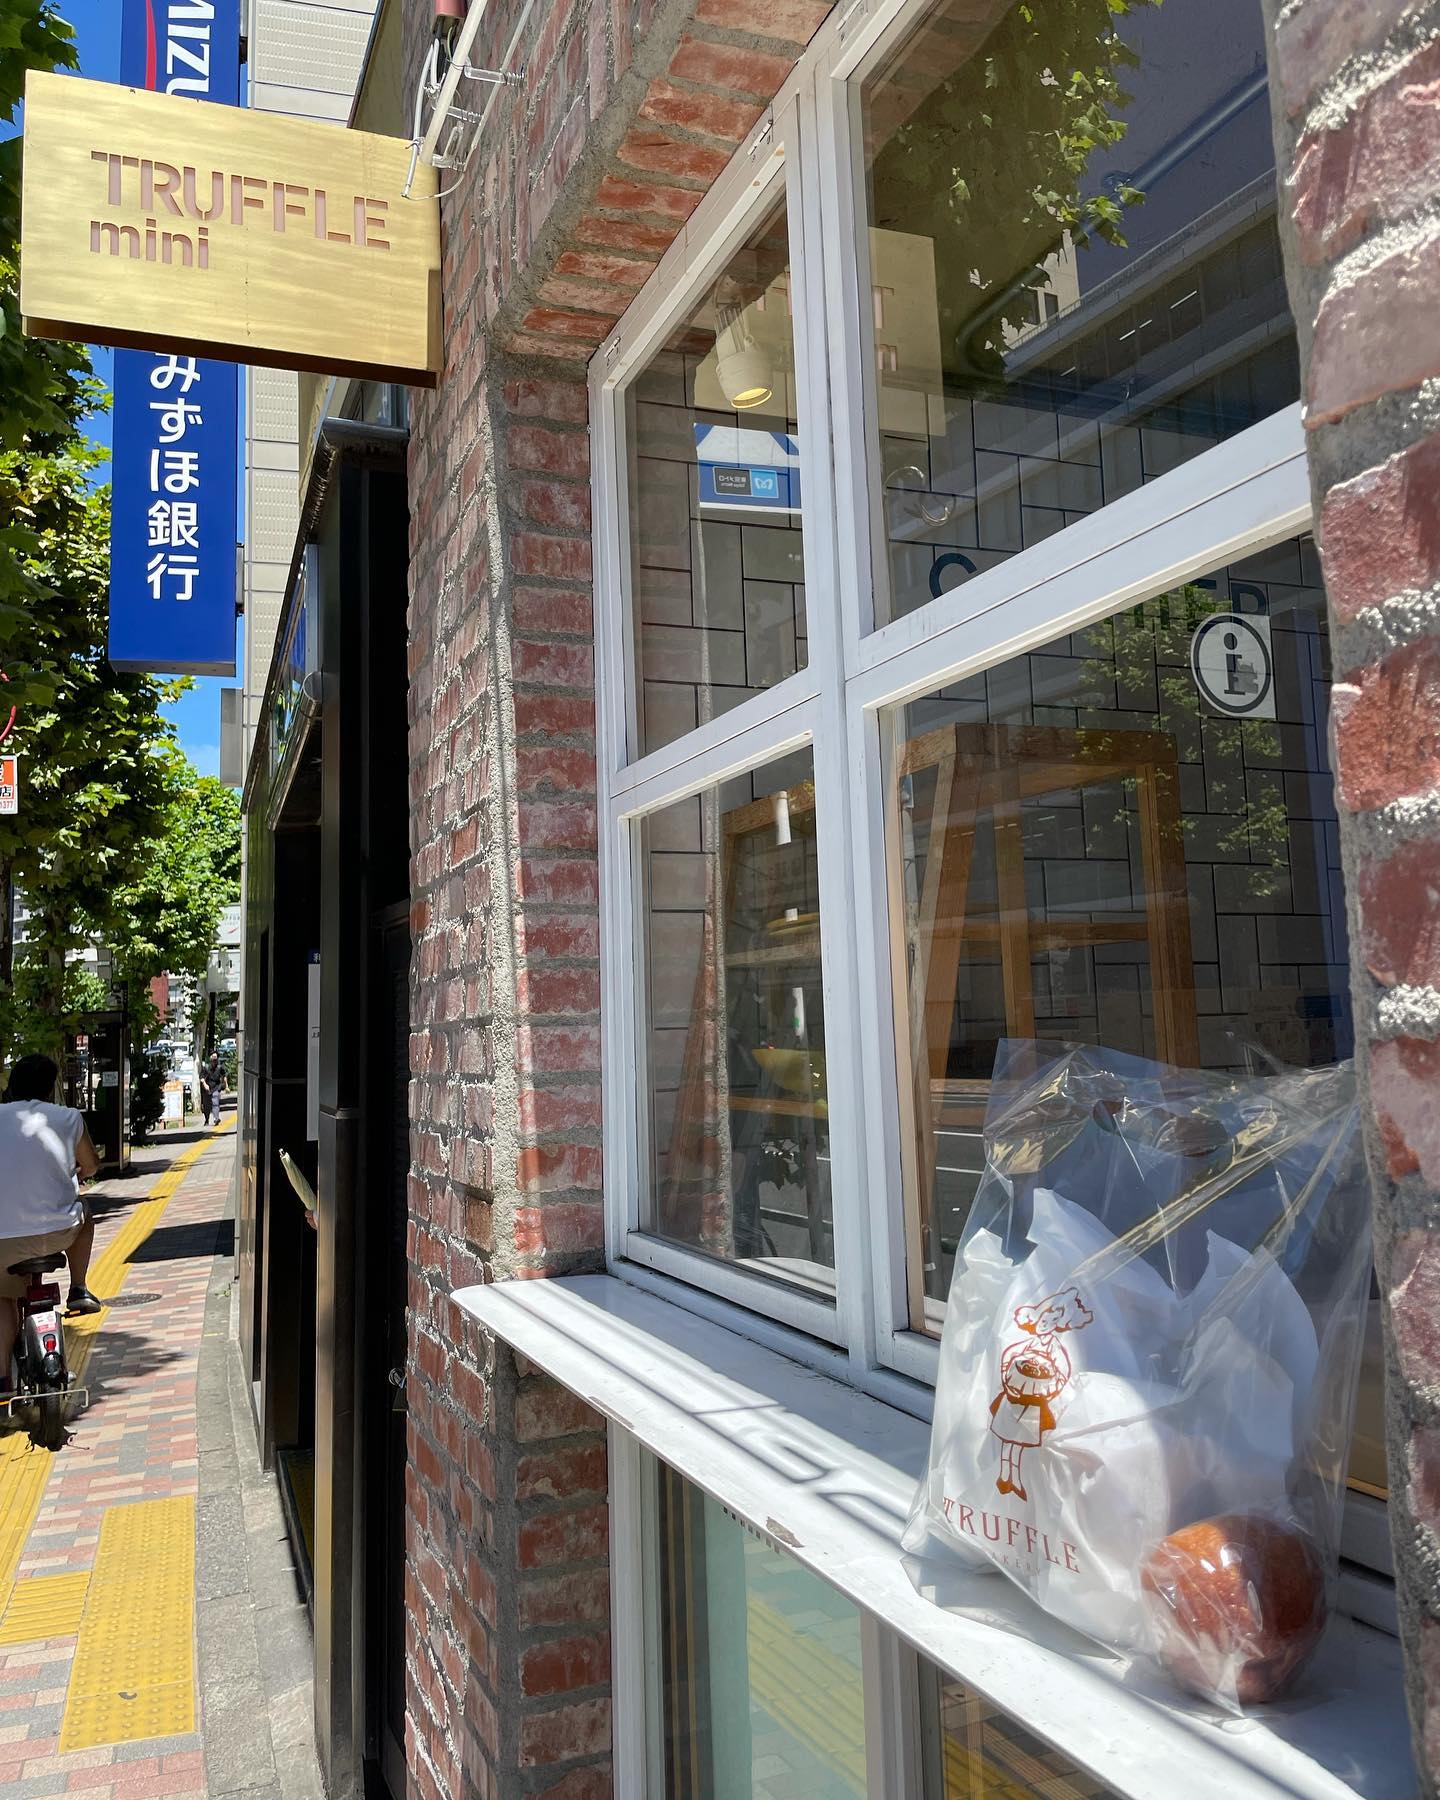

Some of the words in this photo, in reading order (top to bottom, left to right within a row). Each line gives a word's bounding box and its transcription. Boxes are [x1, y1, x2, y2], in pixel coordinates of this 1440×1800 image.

[90, 218, 209, 269] mini
[91, 150, 391, 251] TRUFFLE
[147, 353, 203, 601] みずほ銀行
[943, 1497, 1081, 1574] TRUFFLE
